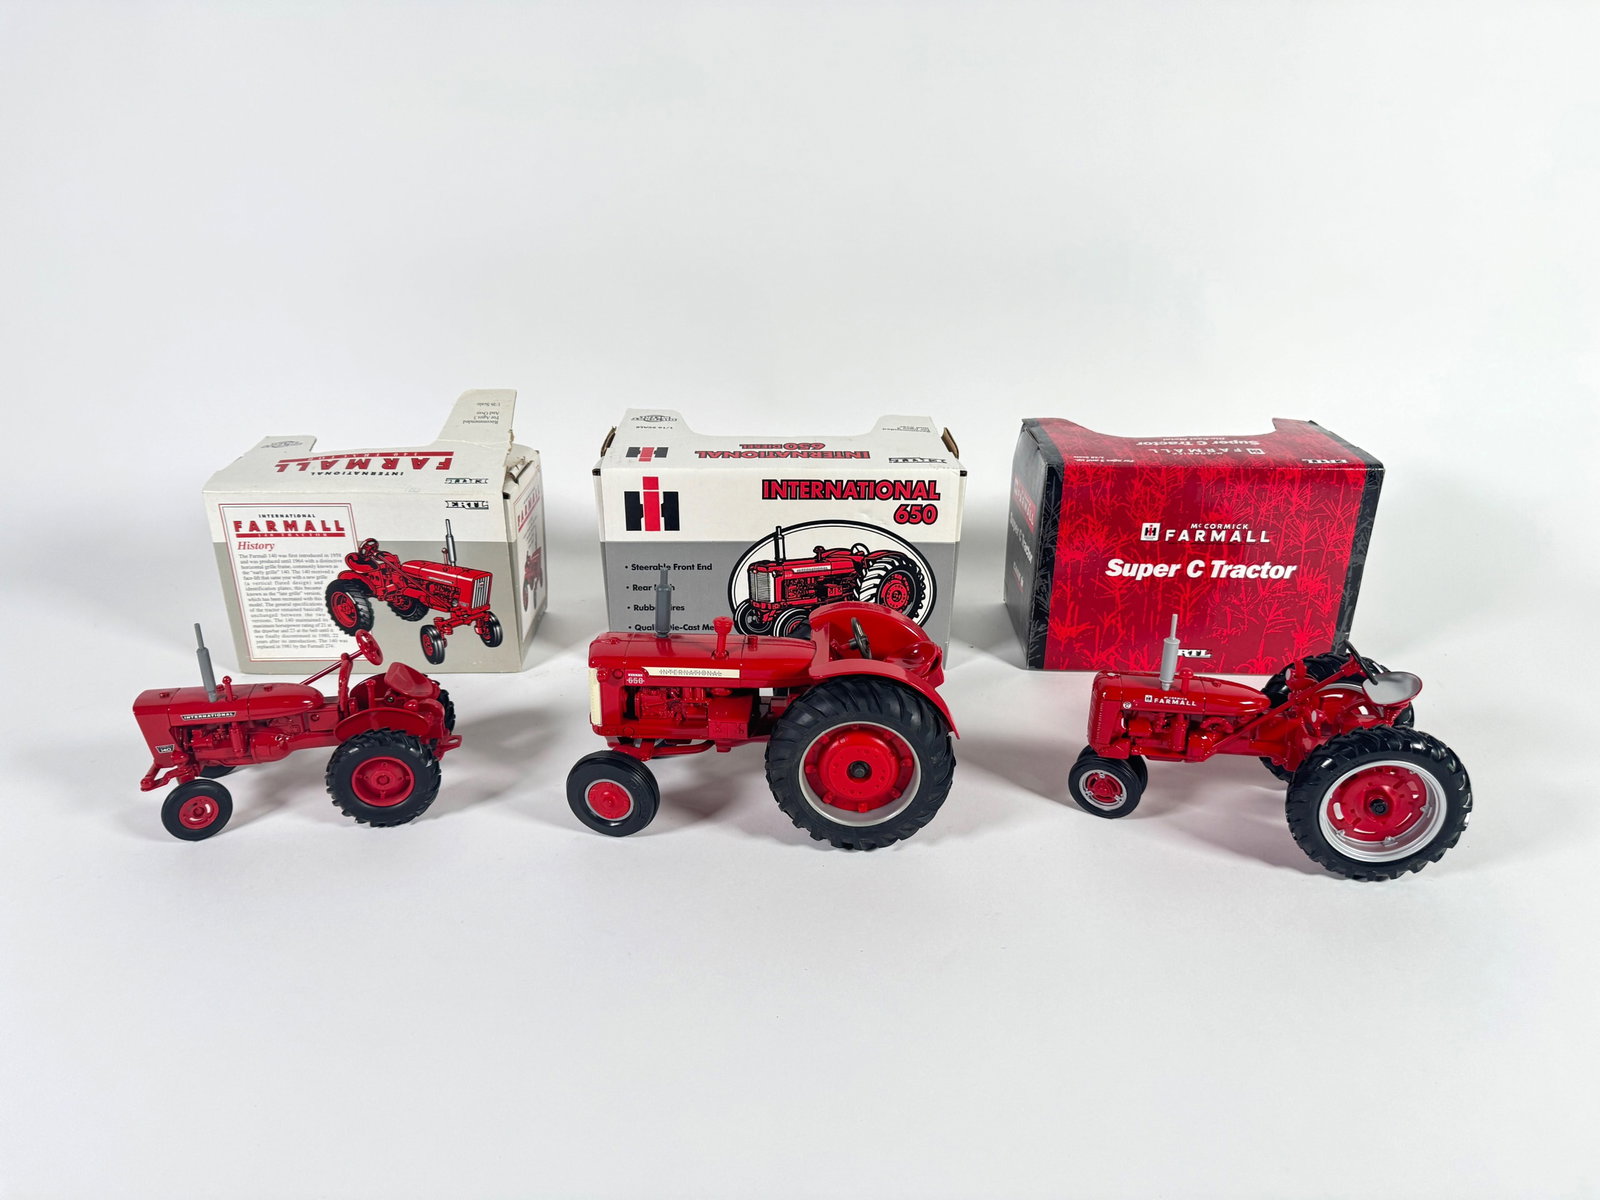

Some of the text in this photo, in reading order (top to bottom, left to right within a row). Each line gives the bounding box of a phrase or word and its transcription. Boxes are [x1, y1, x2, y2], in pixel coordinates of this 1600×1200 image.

[275, 458, 452, 472] FARMALL
[762, 479, 940, 500] INTERNATIONAL
[445, 500, 489, 510] ERTL
[894, 504, 938, 525] 650
[233, 520, 344, 532] FARMALL
[1165, 530, 1270, 543] FARMALL
[238, 542, 275, 551] History
[1105, 559, 1297, 580] Super C Tractor
[1176, 649, 1211, 658] RTL
[1154, 698, 1197, 706] FARMALL
